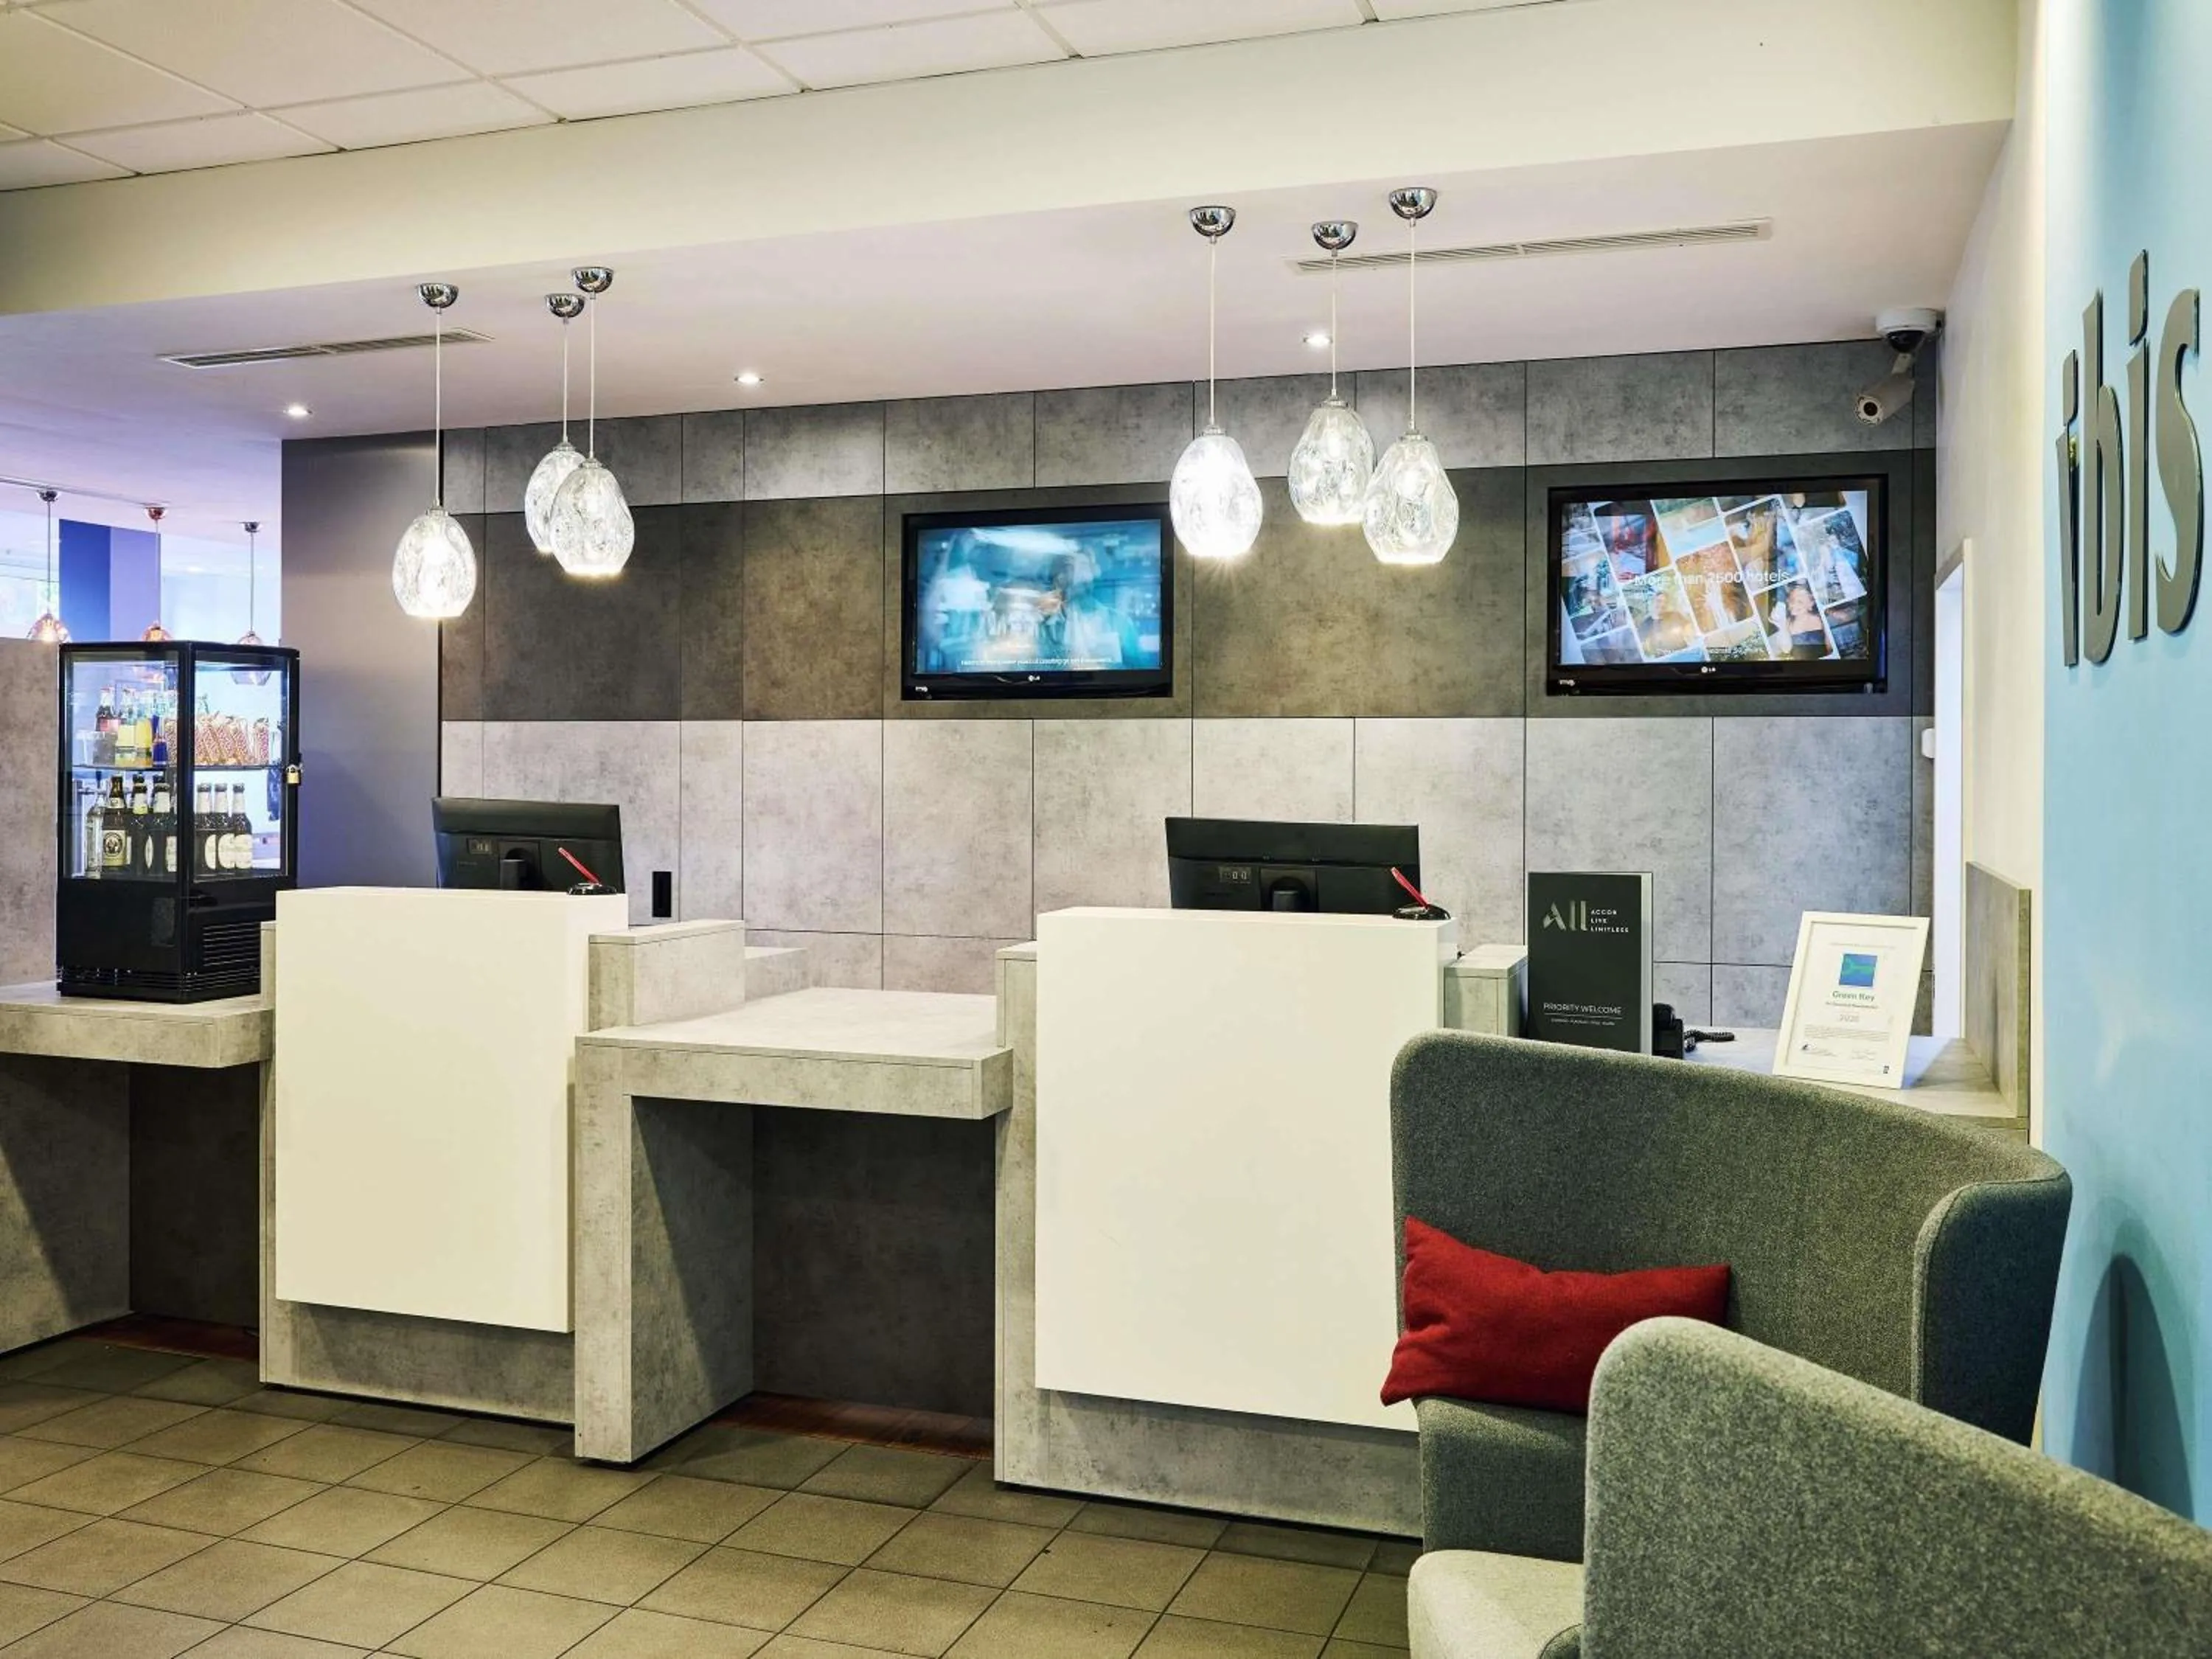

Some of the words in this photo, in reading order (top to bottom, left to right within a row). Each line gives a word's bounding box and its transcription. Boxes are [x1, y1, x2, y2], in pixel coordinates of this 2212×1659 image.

[2056, 248, 2205, 667] ibis
[1832, 990, 1857, 1000] Green
[1859, 993, 1875, 1002] Key
